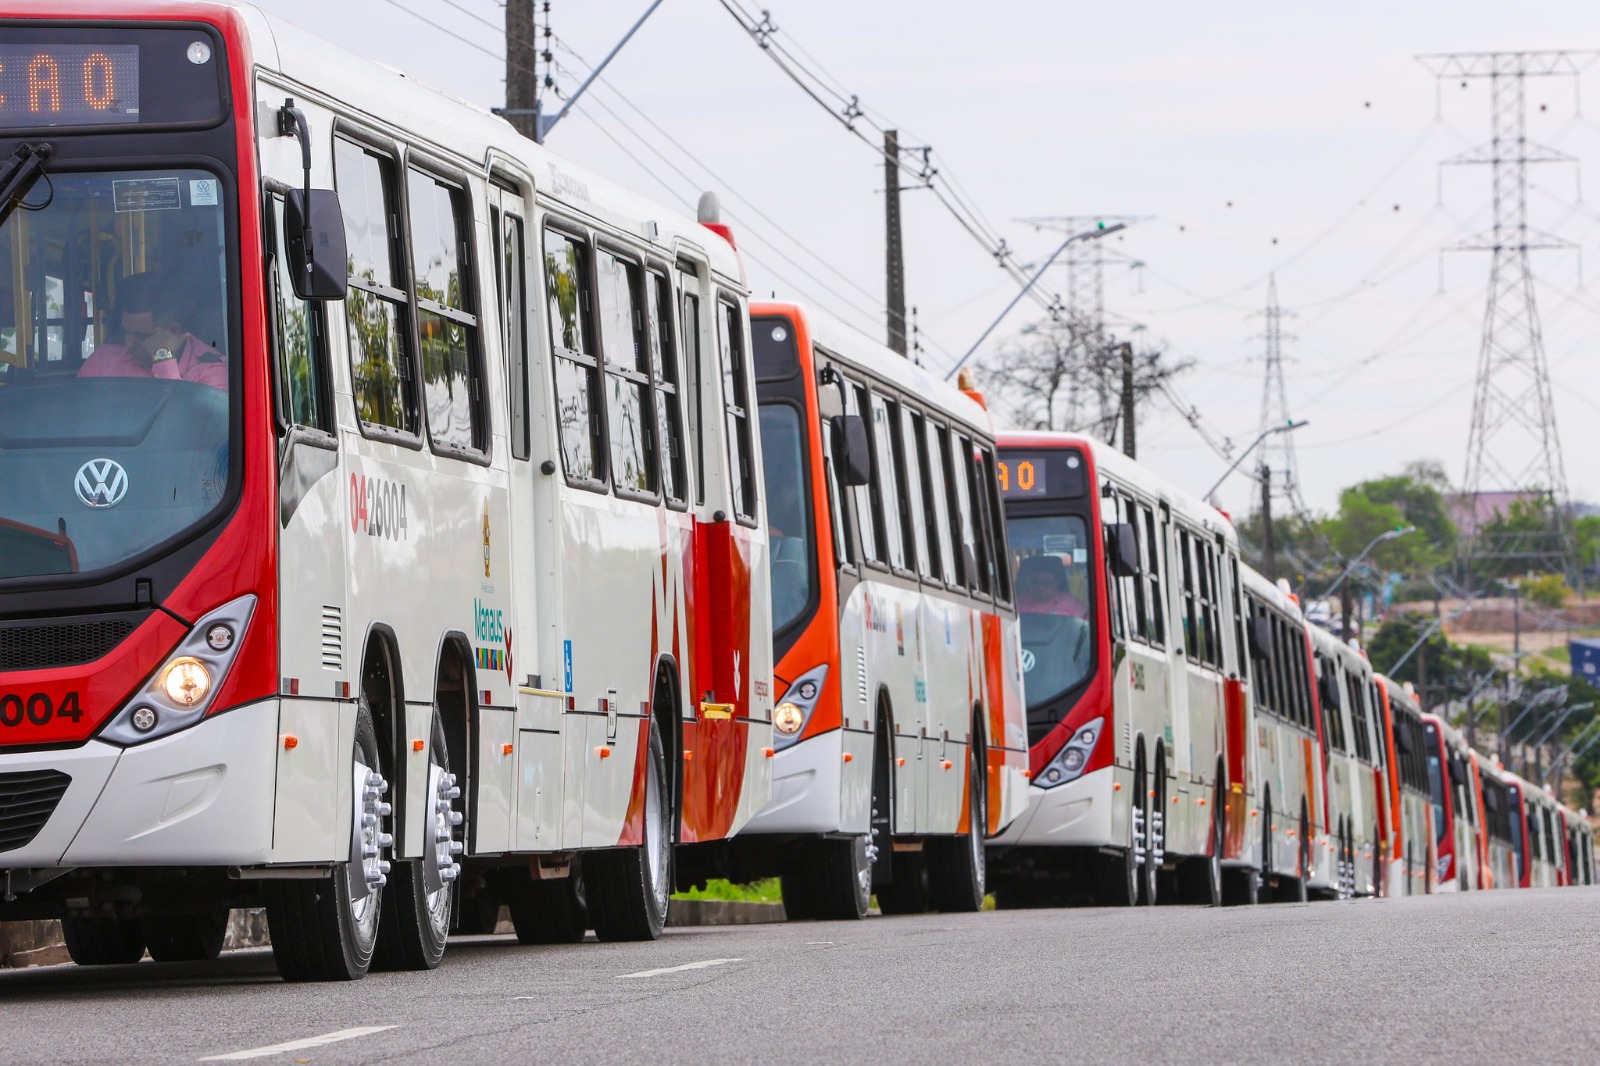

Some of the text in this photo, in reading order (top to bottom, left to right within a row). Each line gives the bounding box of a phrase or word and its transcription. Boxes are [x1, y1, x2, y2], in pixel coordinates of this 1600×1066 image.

[0, 52, 115, 112] AO
[349, 472, 407, 542] 0426004
[474, 598, 503, 644] Manaus
[0, 692, 83, 727] 004
